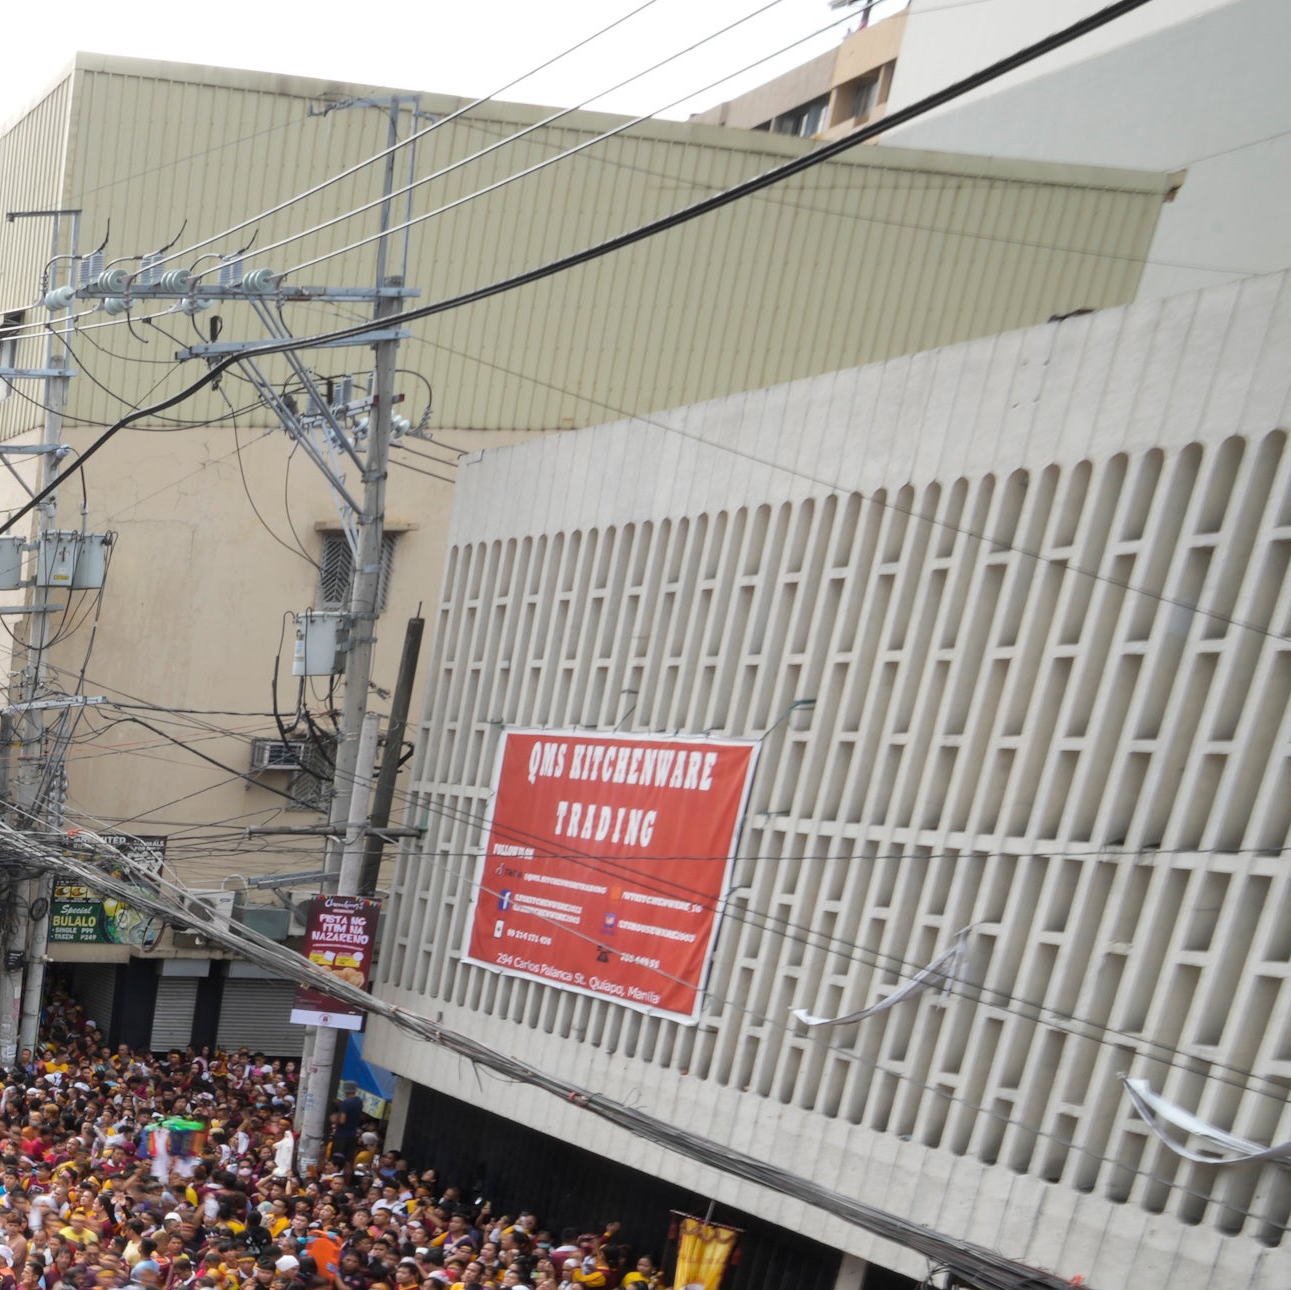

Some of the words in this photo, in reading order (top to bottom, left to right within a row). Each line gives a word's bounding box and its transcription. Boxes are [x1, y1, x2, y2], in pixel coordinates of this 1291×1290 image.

[527, 742, 568, 784] QMS
[569, 743, 718, 792] KITCHENWARE
[555, 800, 658, 848] TRADING
[60, 904, 93, 916] Special
[52, 915, 97, 927] BULALO
[319, 914, 348, 924] PISTA
[350, 916, 367, 926] NG
[350, 925, 364, 935] NA
[311, 931, 369, 945] NAZARENO
[495, 952, 513, 966] 294
[513, 956, 540, 974] Carlos
[540, 963, 573, 982] Palanca
[626, 986, 661, 1004] Manila
